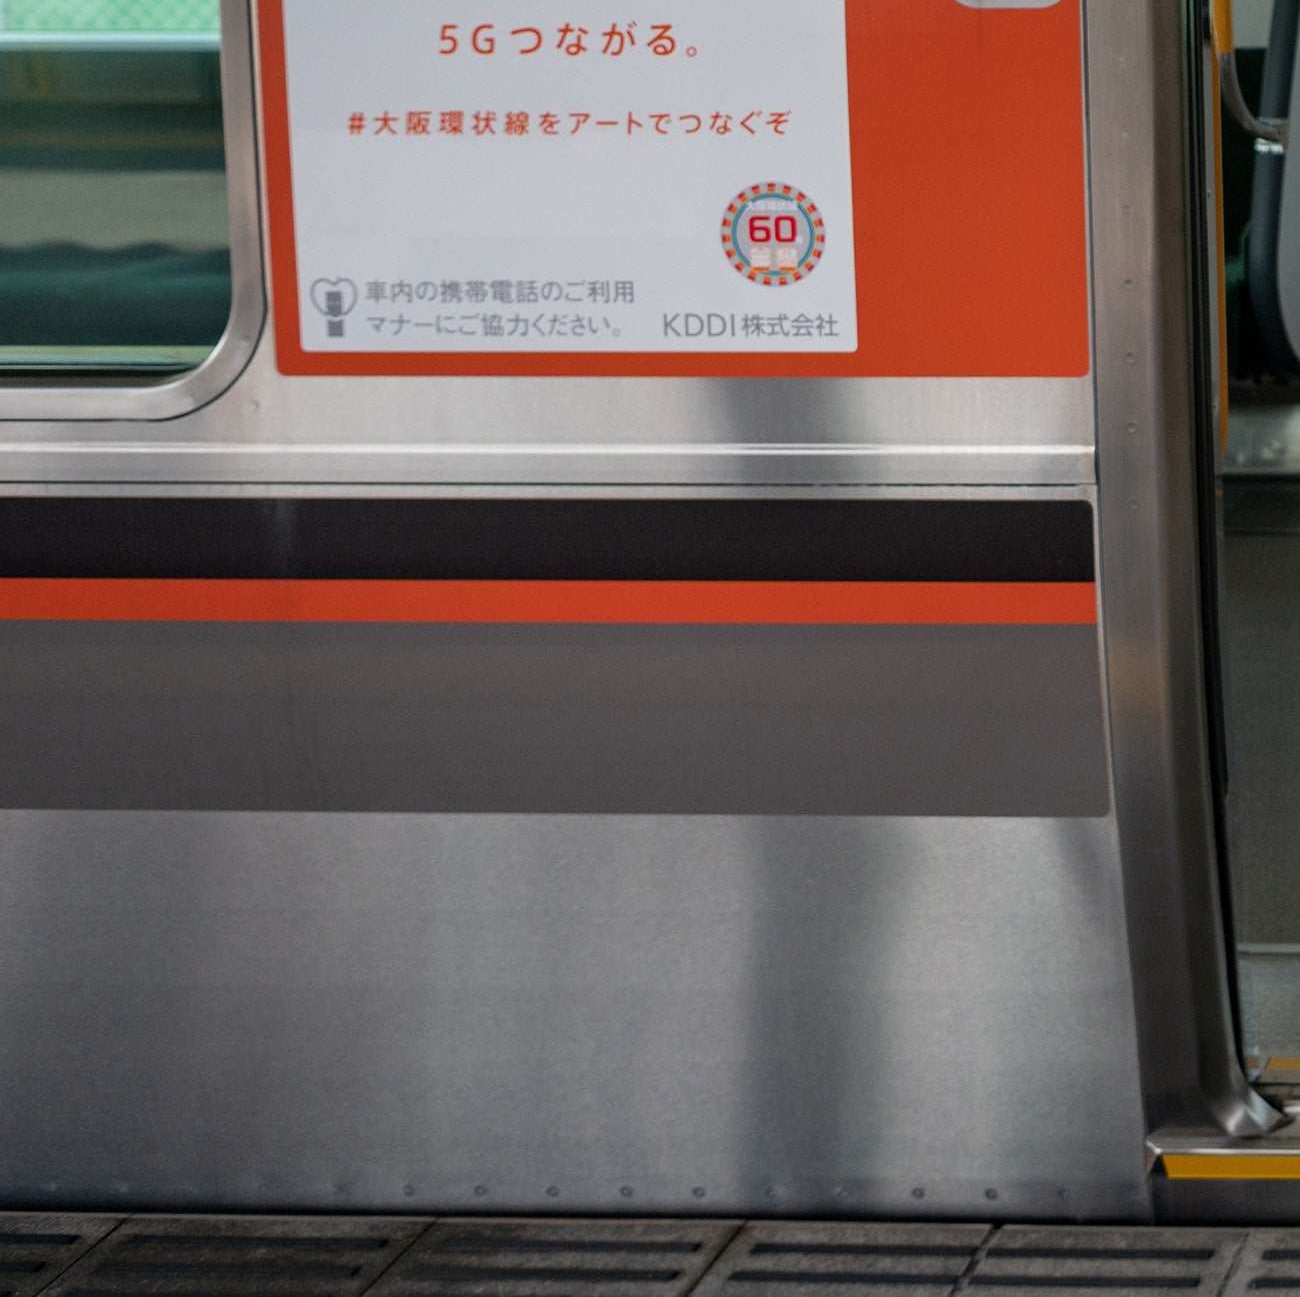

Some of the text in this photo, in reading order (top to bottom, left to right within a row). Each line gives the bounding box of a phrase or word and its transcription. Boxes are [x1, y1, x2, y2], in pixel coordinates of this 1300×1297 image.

[438, 23, 700, 57] 5Gつながる。
[348, 110, 791, 136] #大阪環状線をアートでつなぐぞ
[748, 215, 797, 243] 60
[366, 279, 635, 304] 車内の携帯電話のご利用
[366, 313, 623, 337] マナーにご協力ください。
